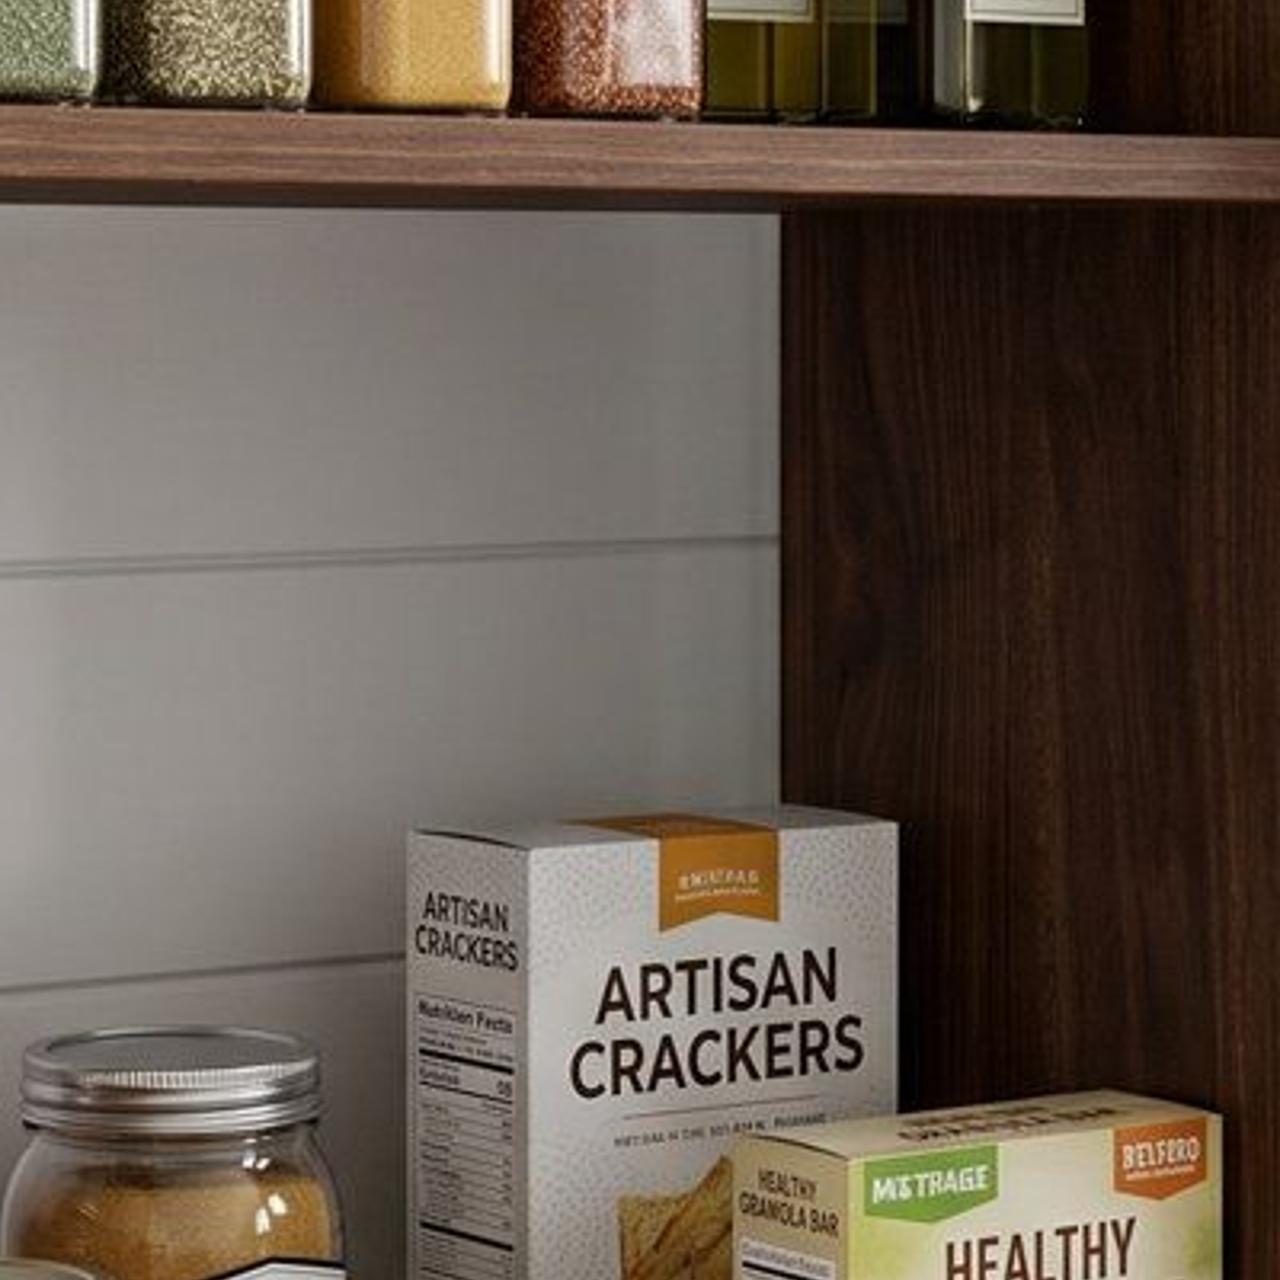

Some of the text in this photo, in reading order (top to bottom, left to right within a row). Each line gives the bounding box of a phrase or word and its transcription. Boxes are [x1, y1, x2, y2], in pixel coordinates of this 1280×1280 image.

[422, 891, 509, 933] ARTISAN
[415, 924, 519, 971] CRACKERS
[595, 946, 838, 1026] ARTISAN
[569, 1015, 865, 1101] CRACKERS
[758, 1168, 817, 1202] HEALTHY
[739, 1192, 839, 1237] GRANOLA BAR
